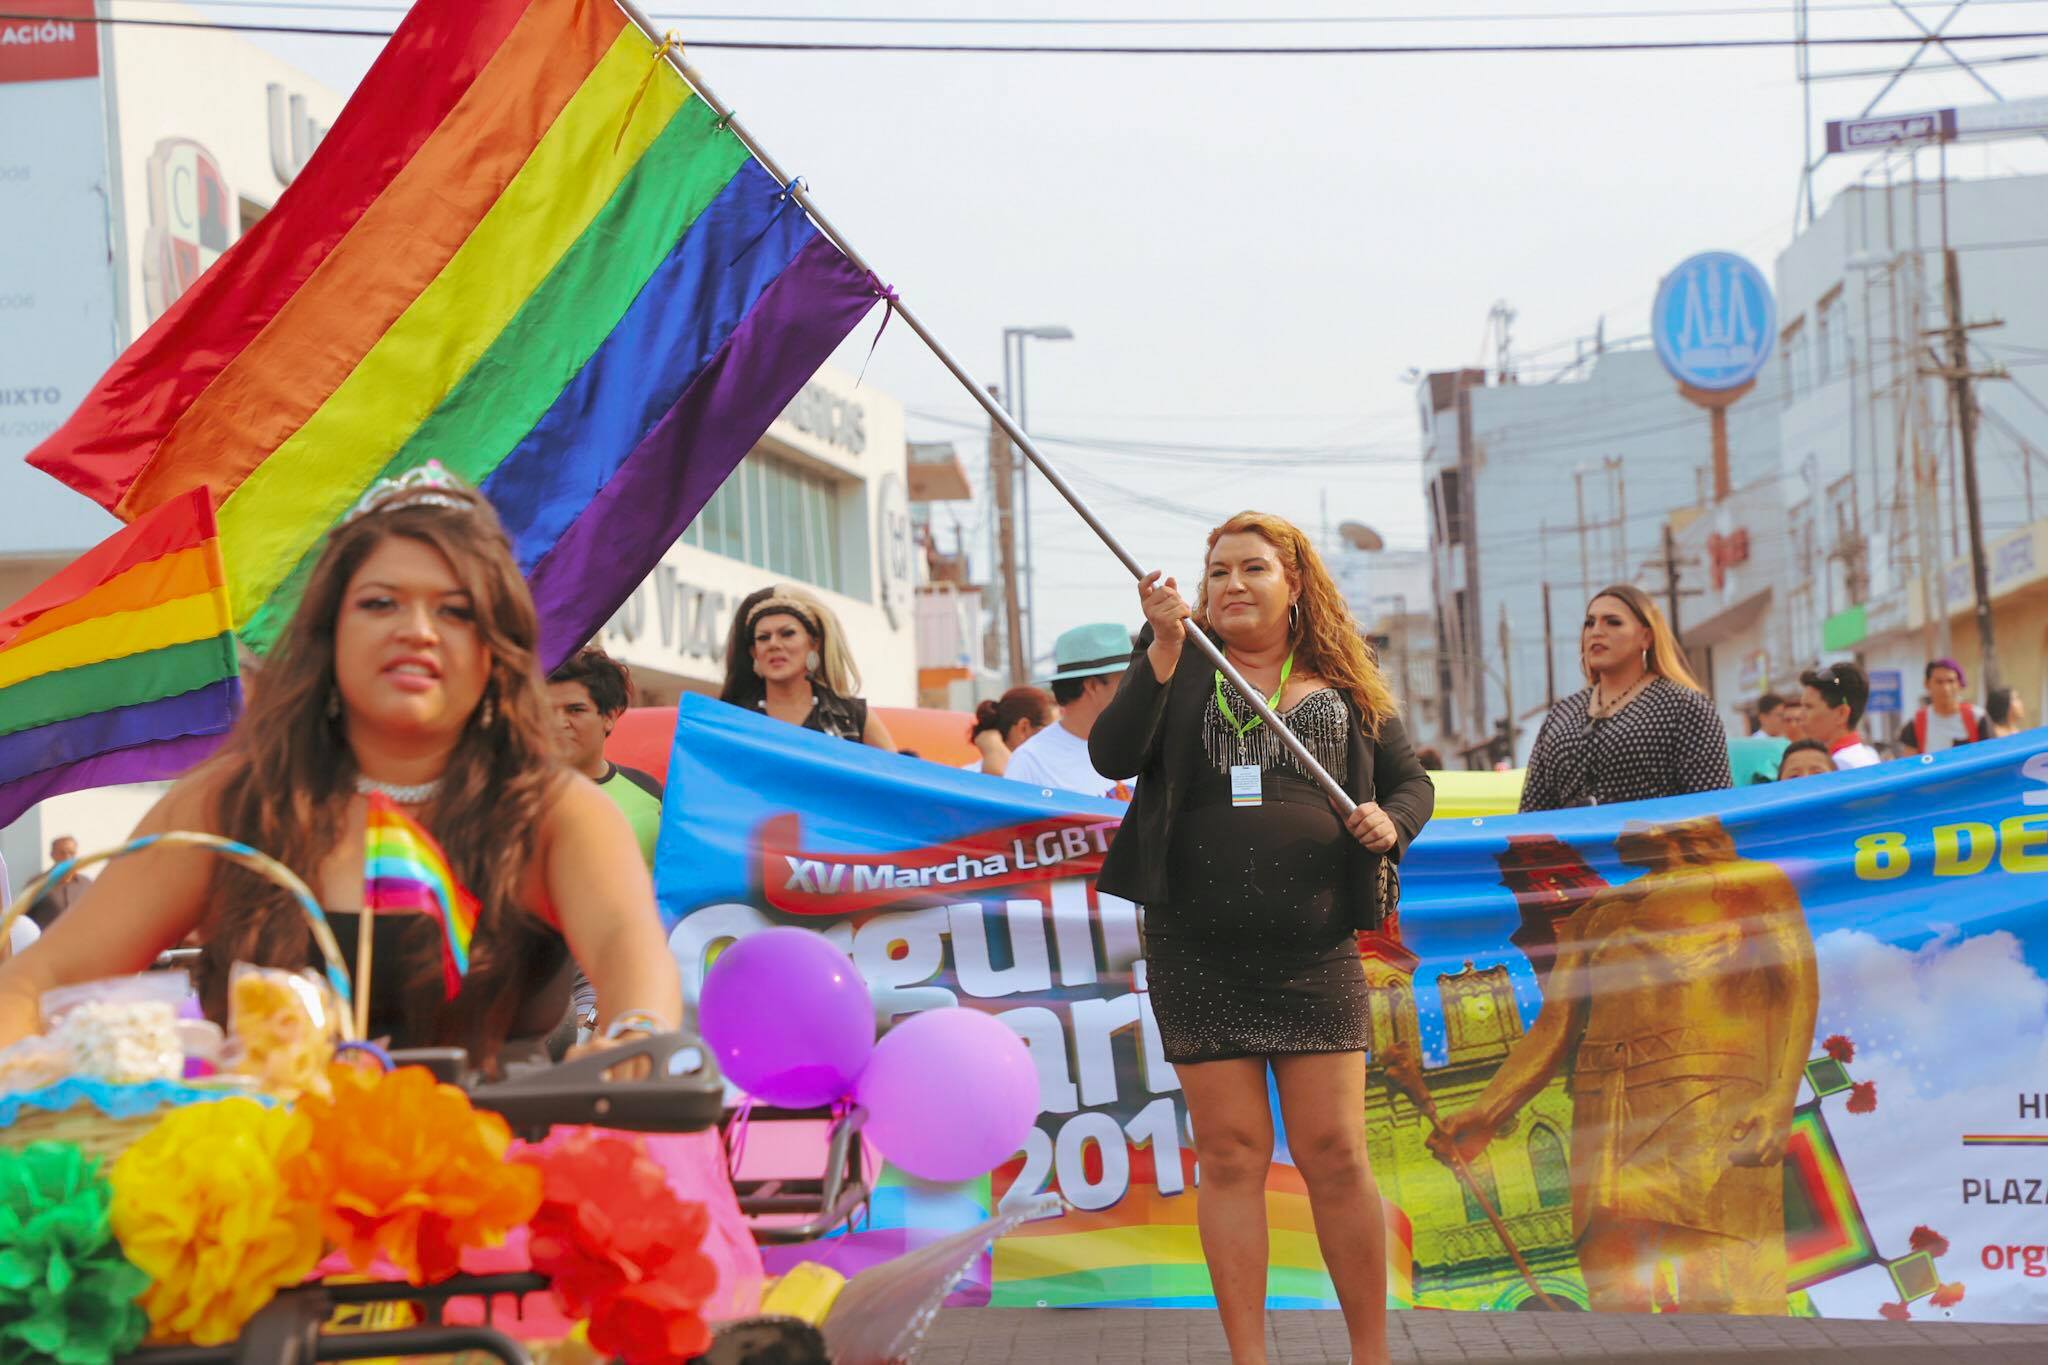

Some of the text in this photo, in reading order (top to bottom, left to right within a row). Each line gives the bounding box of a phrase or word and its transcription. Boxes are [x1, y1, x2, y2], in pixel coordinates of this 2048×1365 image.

[0, 386, 61, 406] IXTO
[1855, 812, 2048, 881] 8 DE
[784, 855, 846, 894] XV
[853, 854, 1009, 893] Marcha
[998, 1096, 1200, 1222] 201
[1962, 1178, 2048, 1205] PLAZ
[1981, 1244, 2048, 1278] org
